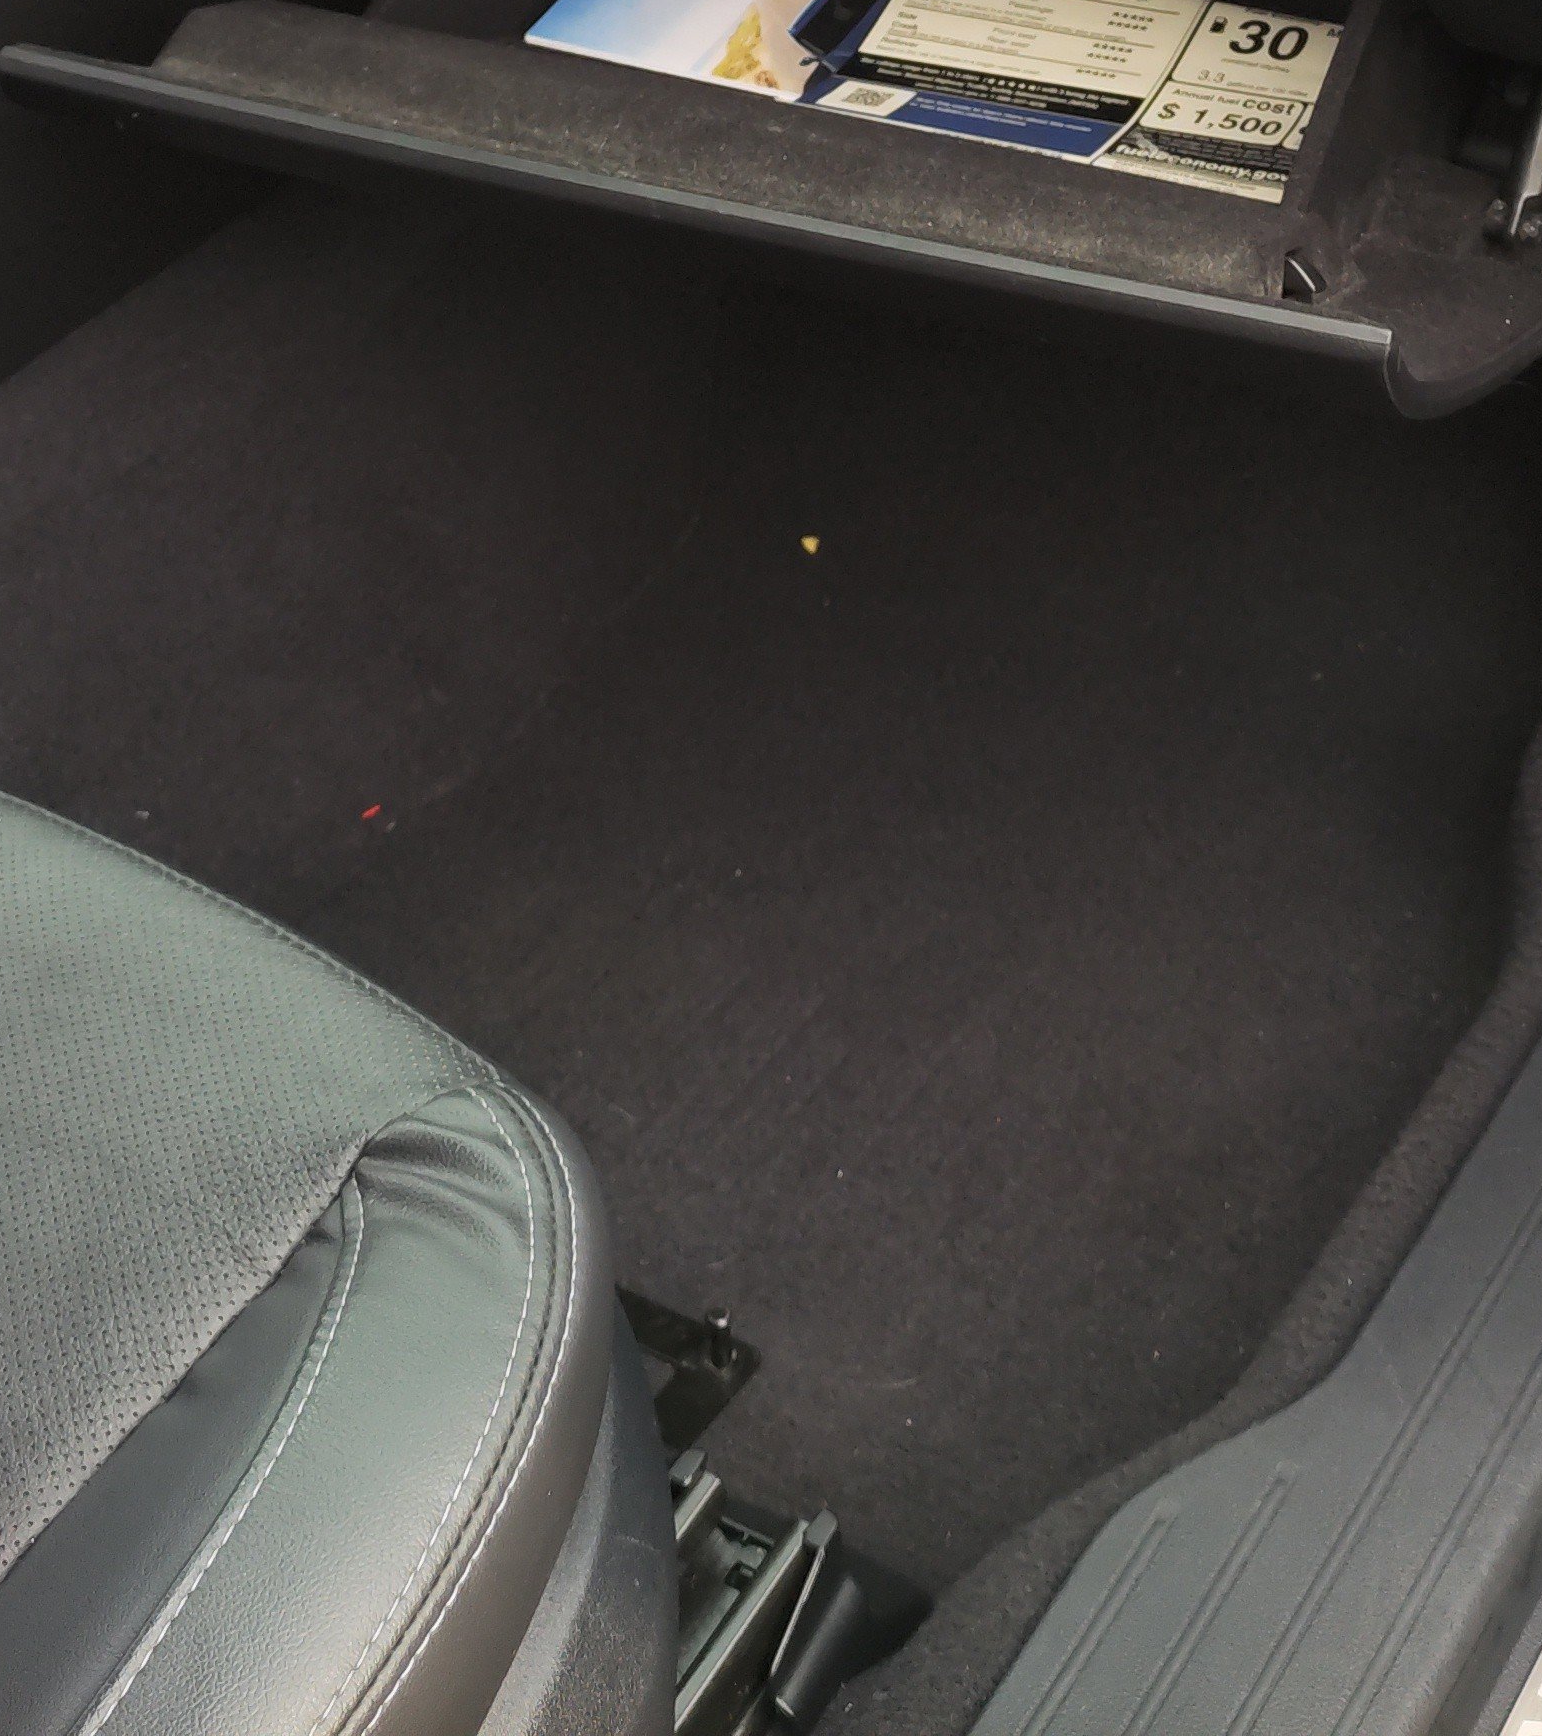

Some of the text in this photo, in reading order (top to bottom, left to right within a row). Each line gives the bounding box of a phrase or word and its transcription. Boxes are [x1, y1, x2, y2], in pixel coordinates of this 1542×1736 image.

[1229, 19, 1309, 61] 30
[1158, 101, 1283, 136] $ 1,500
[1217, 95, 1241, 106] fuel
[1242, 98, 1295, 116] cost
